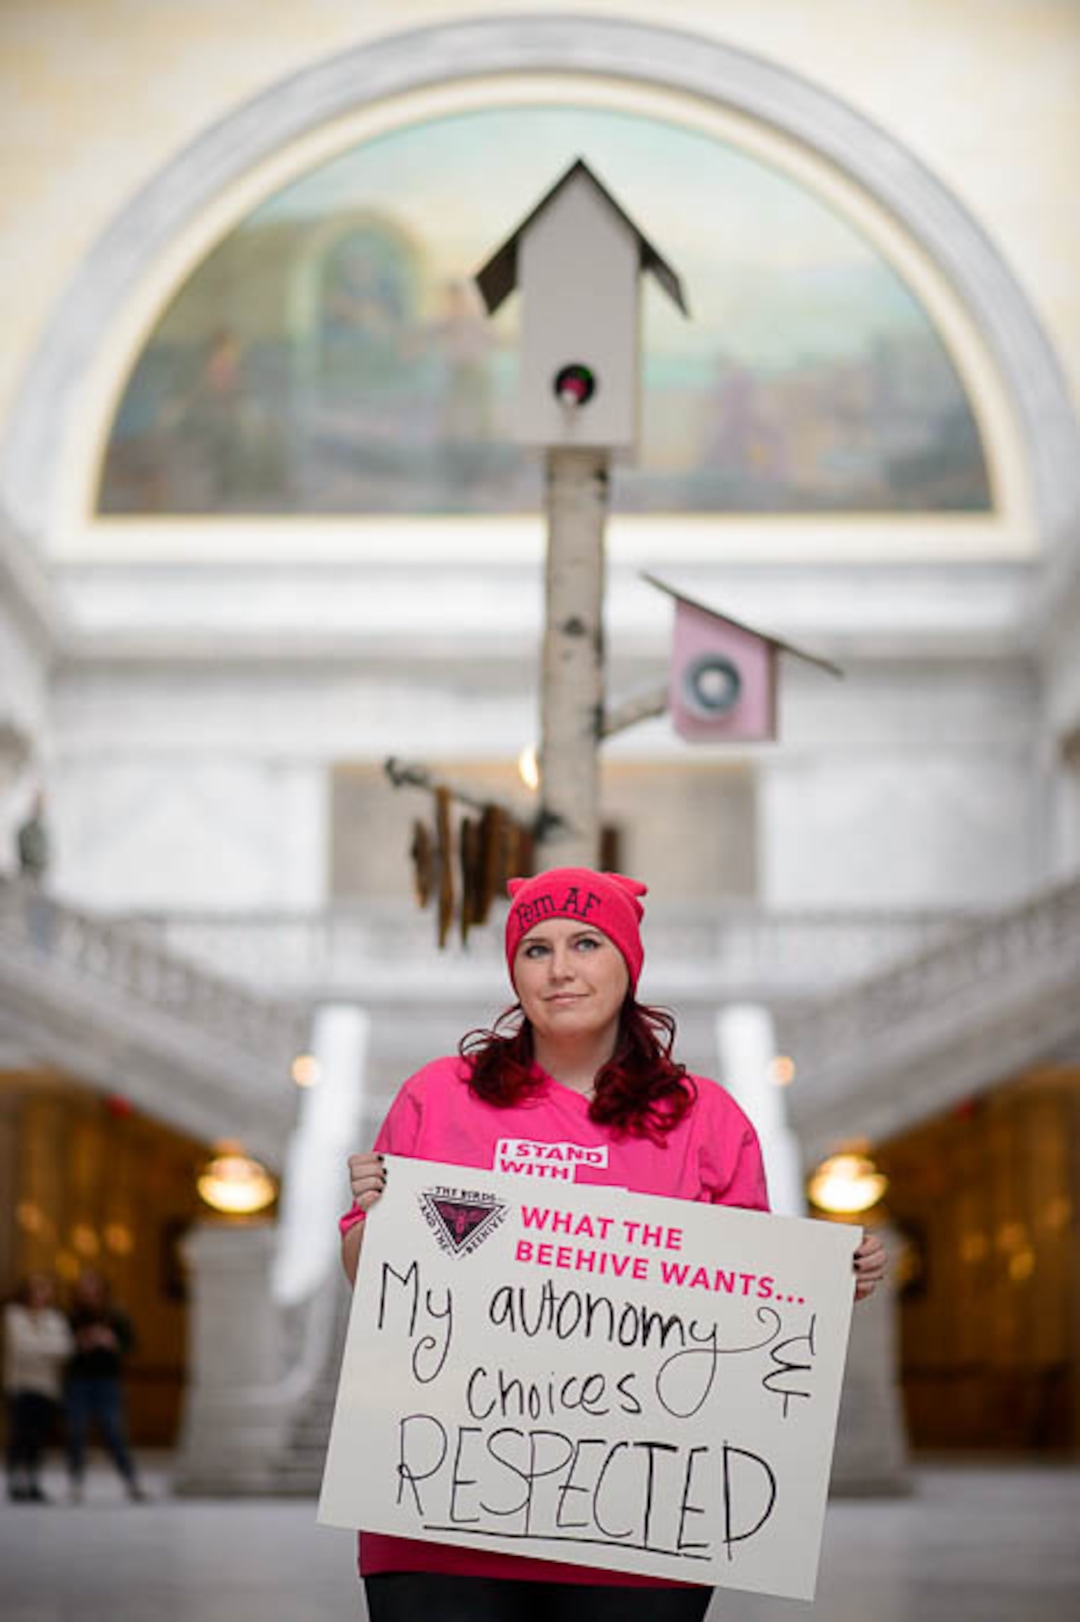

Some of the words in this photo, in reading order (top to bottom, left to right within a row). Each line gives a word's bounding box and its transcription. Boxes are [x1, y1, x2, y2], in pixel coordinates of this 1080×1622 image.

[562, 887, 601, 917] AF
[500, 1159, 569, 1180] WITH
[501, 1142, 508, 1155] I
[516, 1144, 603, 1164] STAND
[435, 1186, 457, 1197] THE
[461, 1190, 496, 1201] BIRDS
[466, 1215, 506, 1254] BEEHIVE
[520, 1204, 614, 1240] WHAT
[624, 1220, 684, 1251] THE
[515, 1240, 648, 1280] BEEHIVE
[660, 1263, 806, 1304] WANTS...
[378, 1261, 453, 1384] My
[489, 1279, 782, 1418] autonomy
[762, 1313, 817, 1419] &
[467, 1367, 642, 1420] choices
[397, 1414, 777, 1561] RESPECTED
